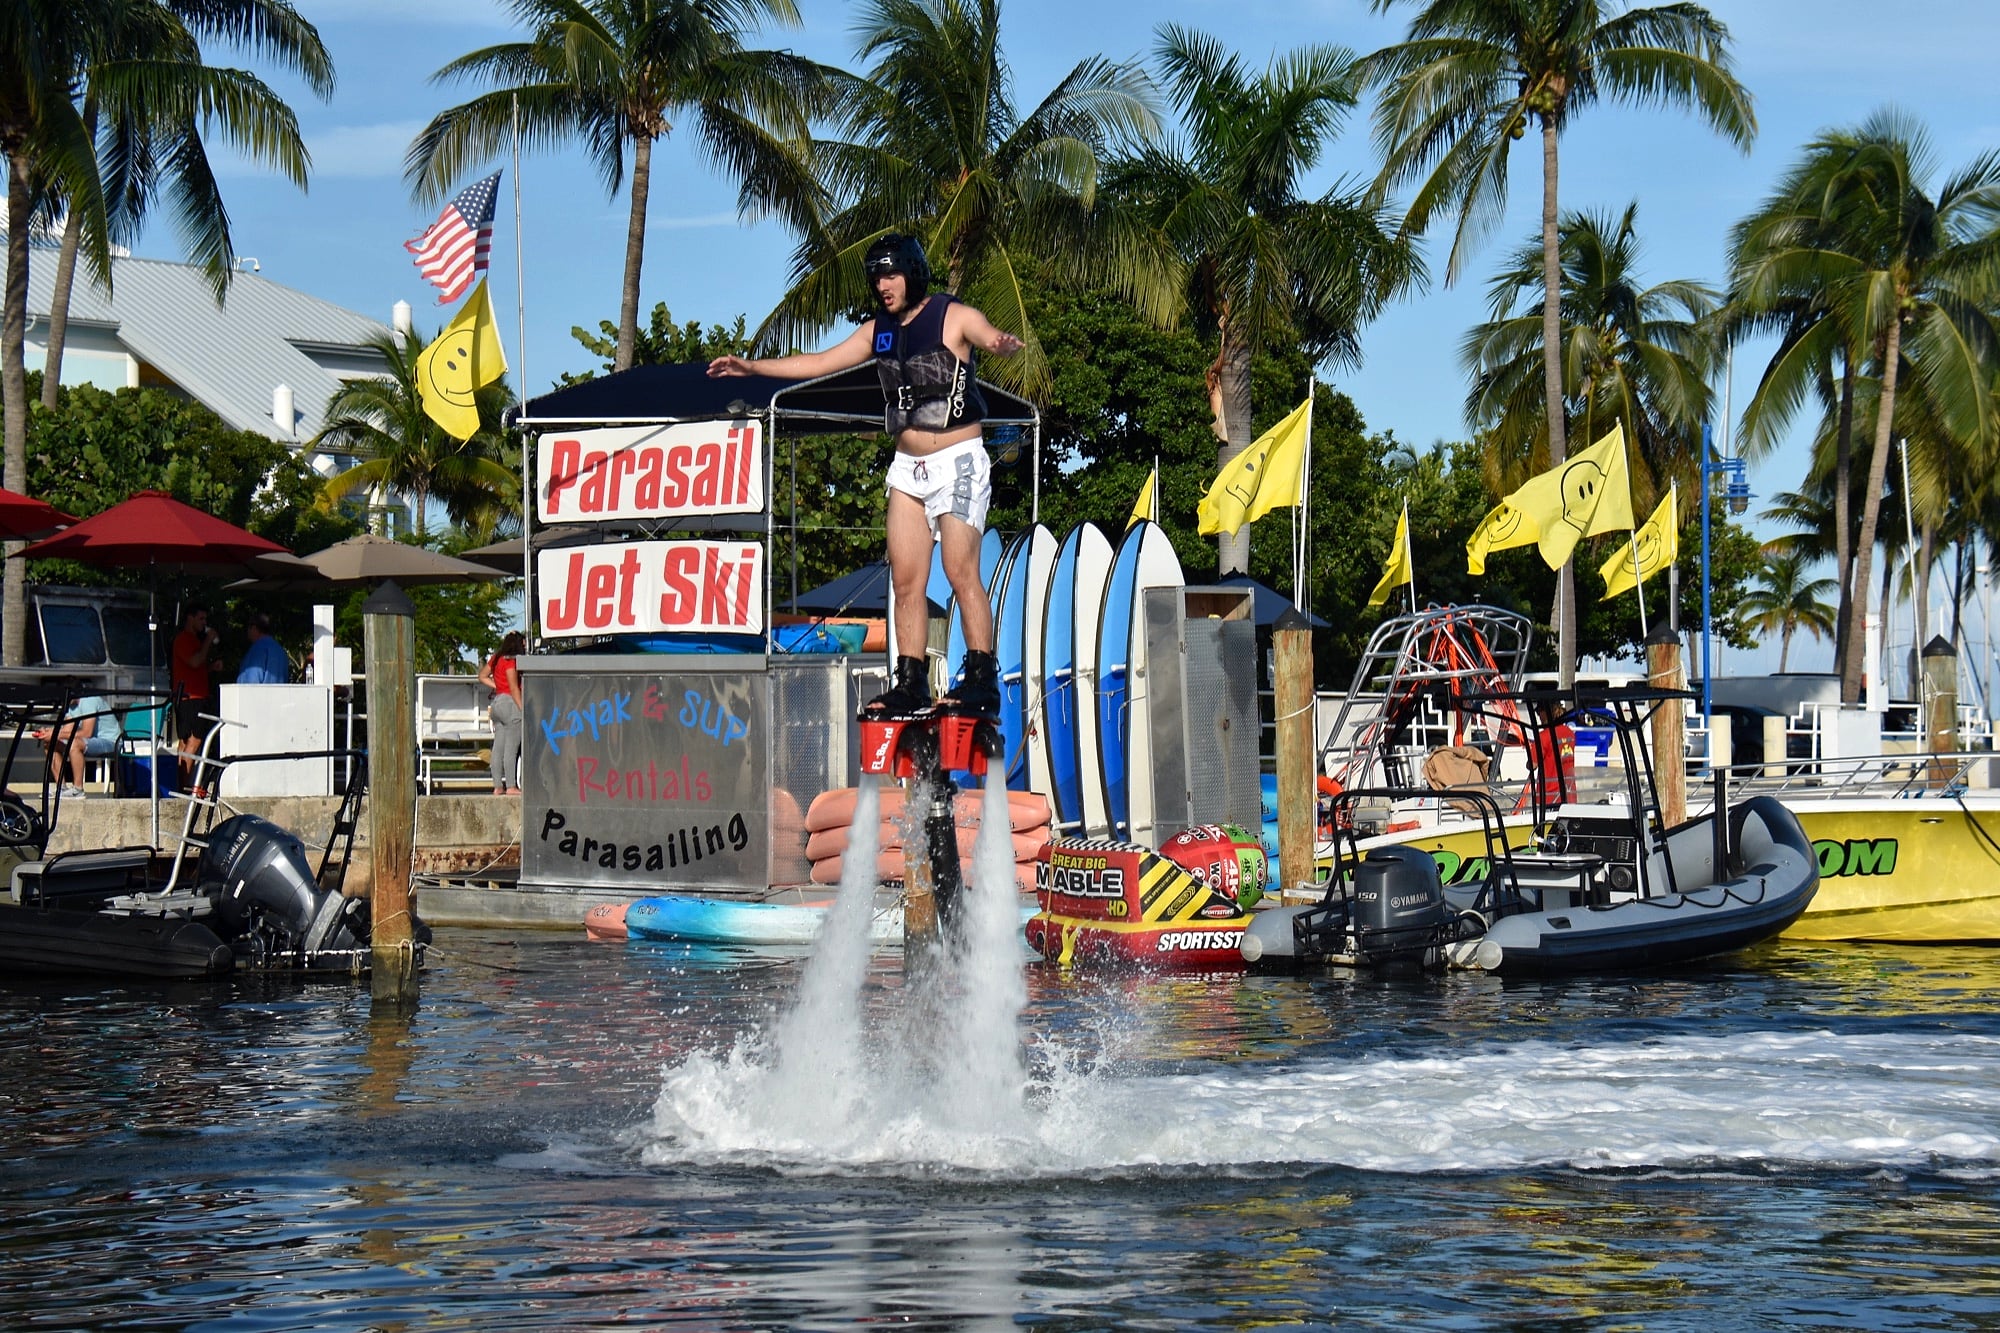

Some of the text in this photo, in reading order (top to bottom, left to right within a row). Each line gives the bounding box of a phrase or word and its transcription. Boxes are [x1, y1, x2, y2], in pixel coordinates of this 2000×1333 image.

[546, 427, 755, 516] Parasail
[546, 546, 756, 631] Jet Ski
[540, 692, 632, 756] Kayak
[679, 689, 749, 747] SUP
[576, 753, 713, 803] Rentals
[540, 807, 749, 872] Parasailing
[1051, 853, 1107, 870] GREAT BIG
[1209, 861, 1221, 889] WO
[1256, 858, 1264, 890] WOW
[1812, 839, 1898, 878] OM
[1036, 861, 1124, 898] MABLE
[1228, 859, 1239, 895] 4K
[1107, 899, 1129, 918] HD
[1357, 891, 1378, 900] 150
[1400, 891, 1429, 907] YAMAHA
[1157, 931, 1245, 952] SPORTSST
